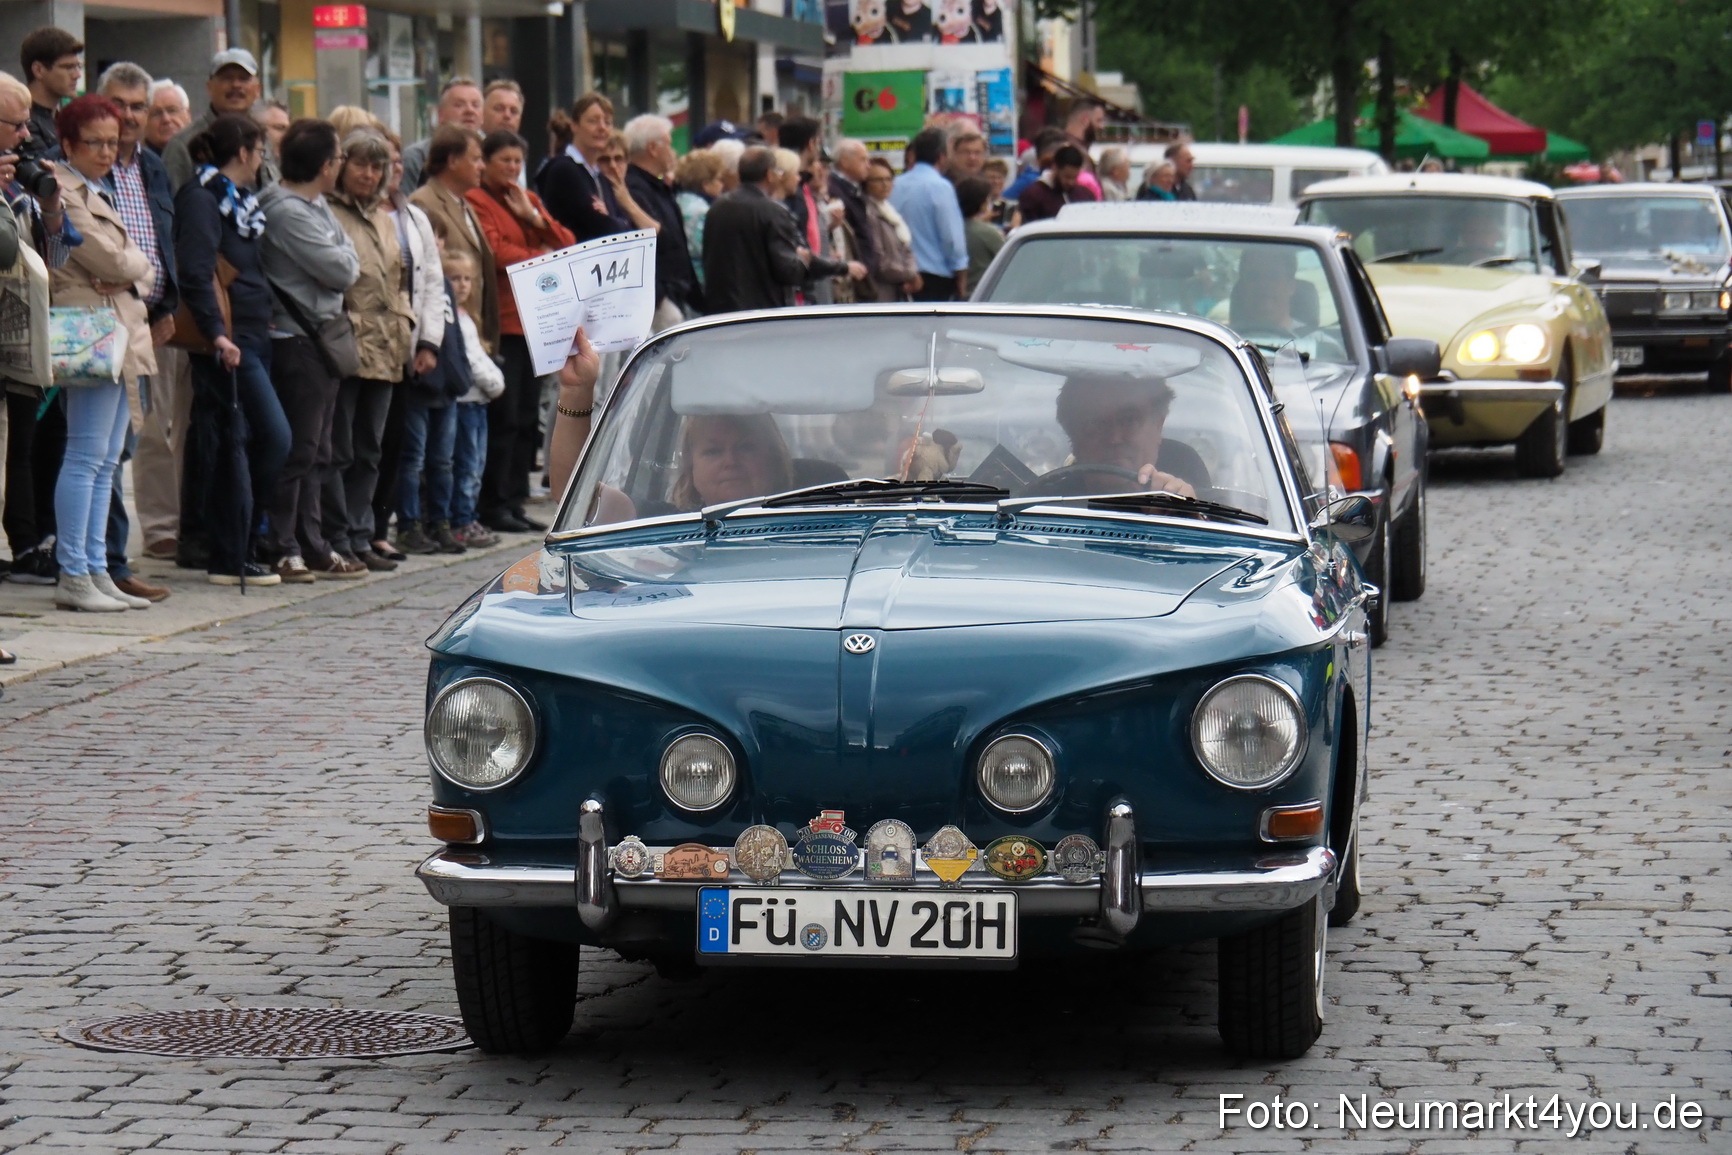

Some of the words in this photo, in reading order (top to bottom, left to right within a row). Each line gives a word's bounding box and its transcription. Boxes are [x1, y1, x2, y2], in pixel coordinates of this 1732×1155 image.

[591, 257, 629, 287] 144
[844, 633, 875, 653] VW
[844, 829, 855, 840] 00
[805, 844, 847, 855] SCHLOSS
[798, 854, 853, 865] WACHENHEIM
[731, 897, 797, 946] FÜ
[834, 899, 899, 947] NV
[910, 900, 1006, 950] 20H
[709, 927, 720, 942] D
